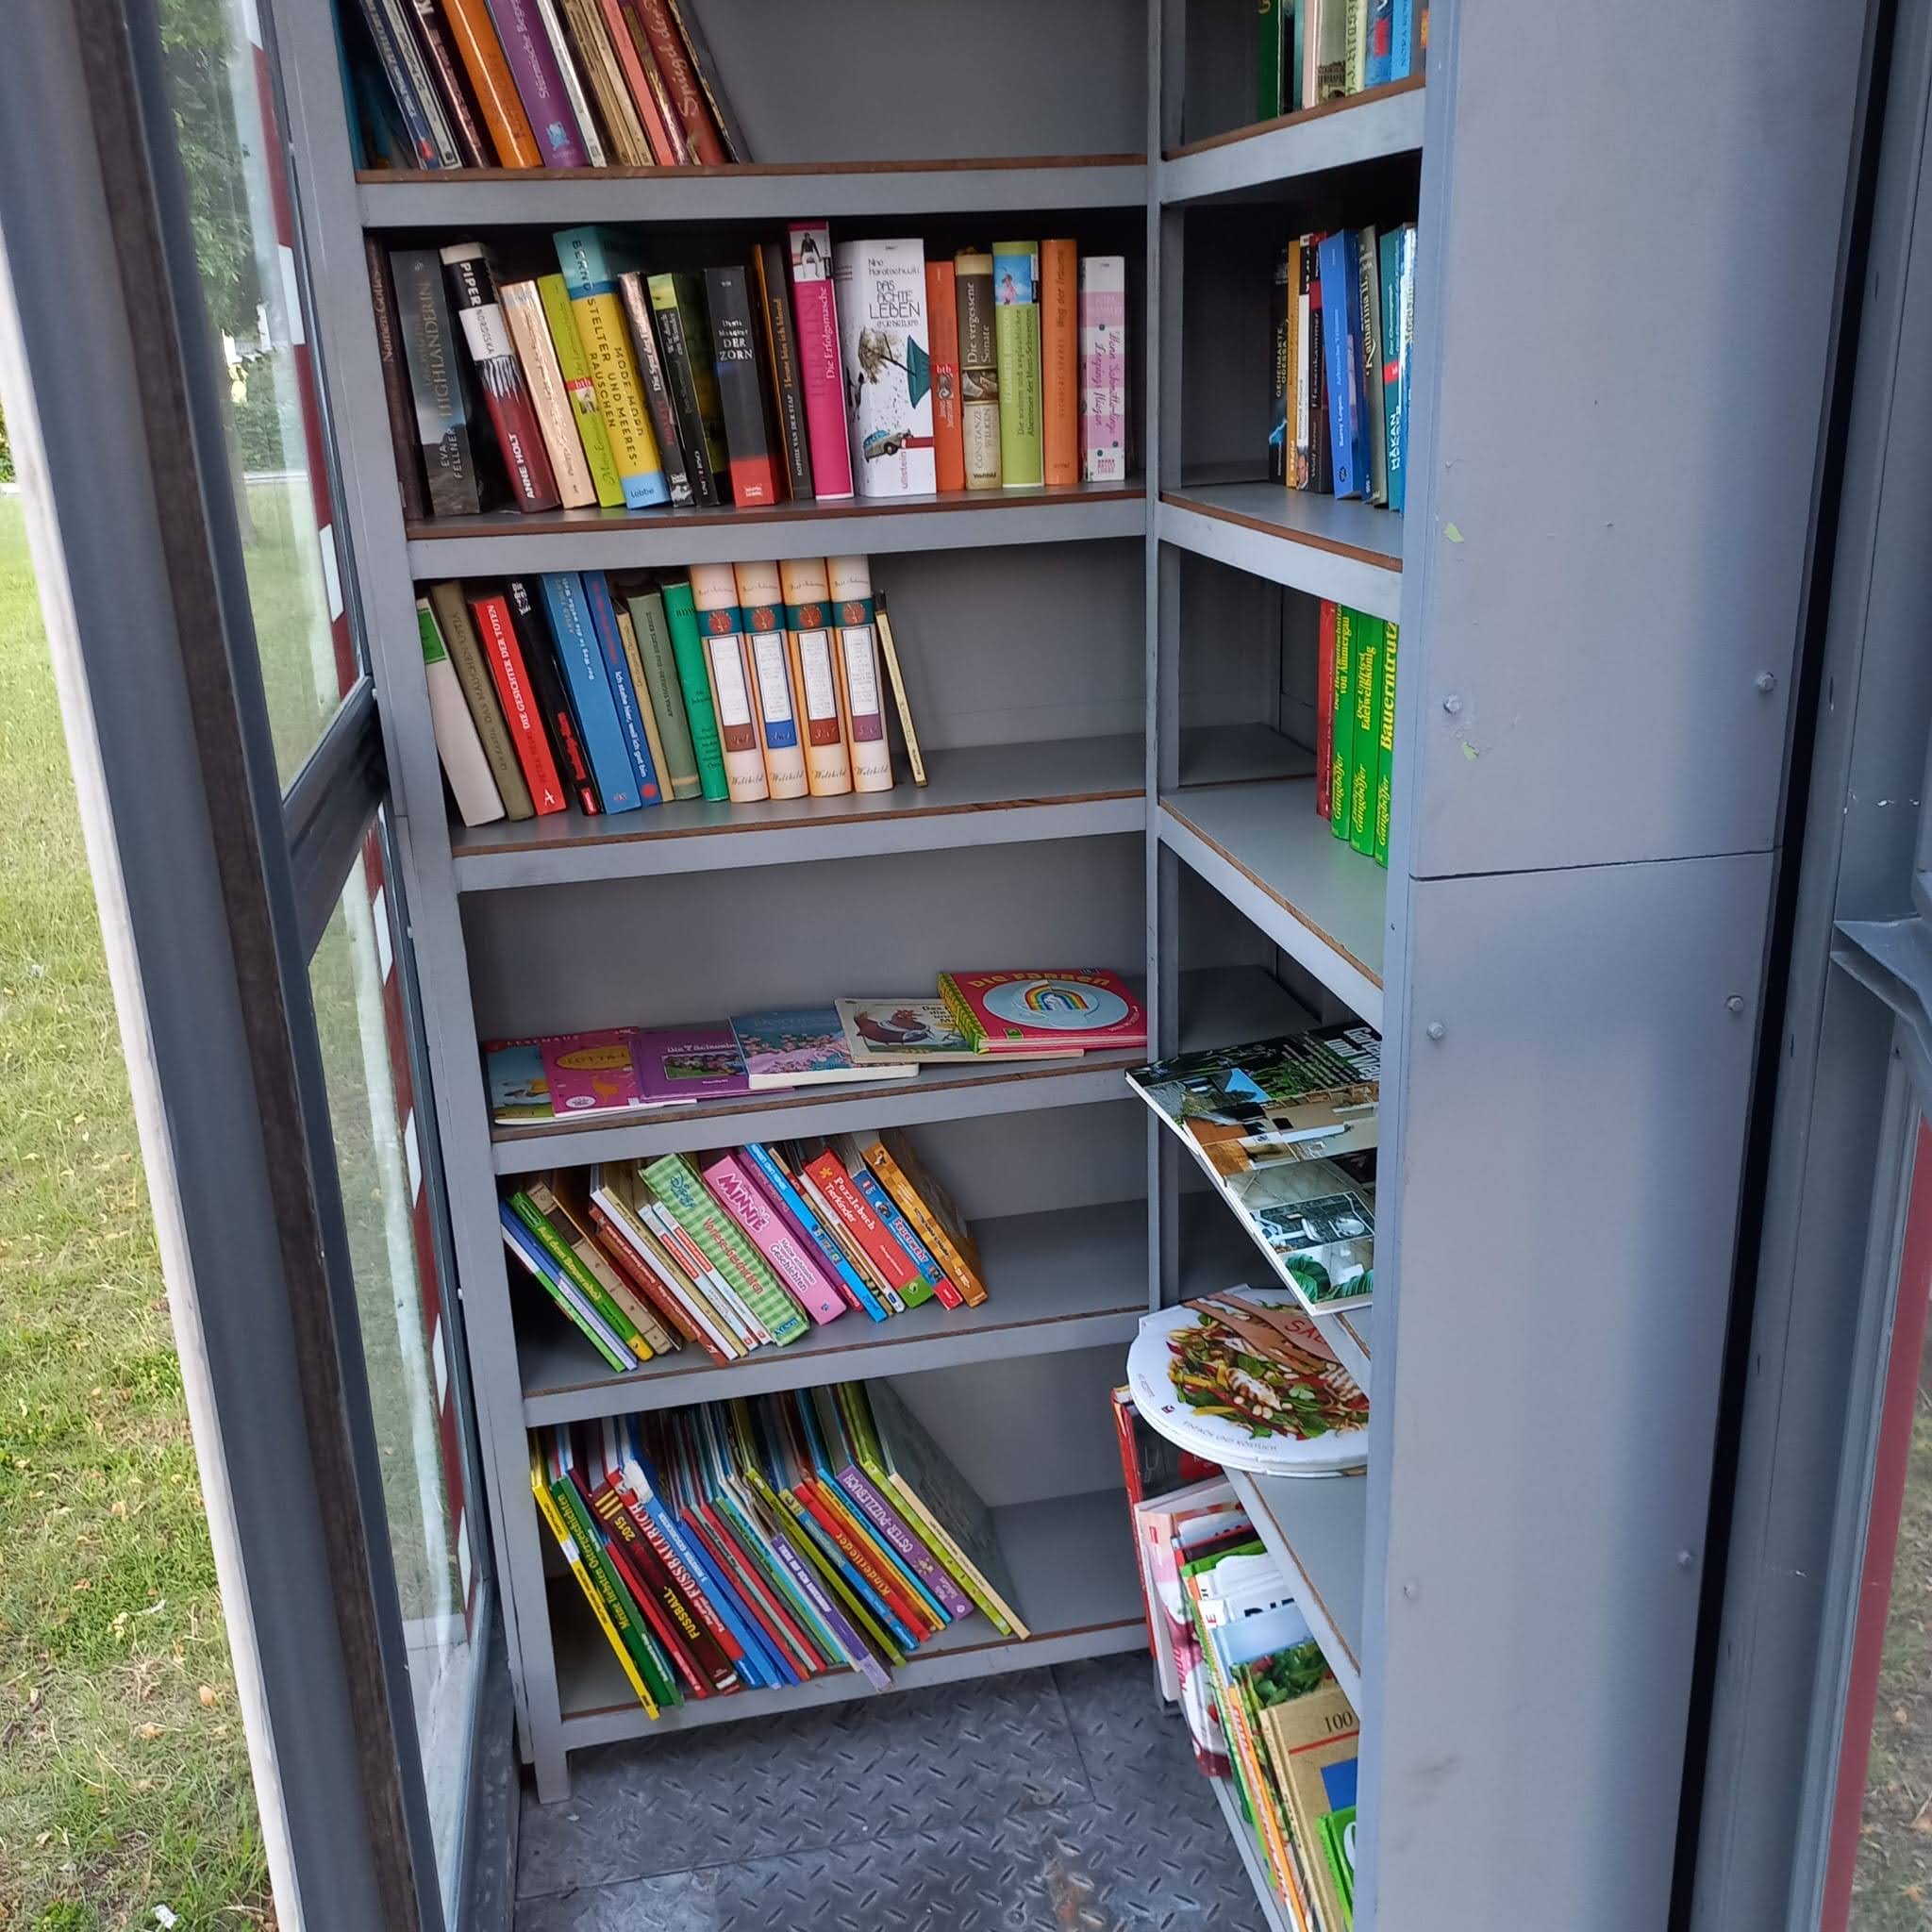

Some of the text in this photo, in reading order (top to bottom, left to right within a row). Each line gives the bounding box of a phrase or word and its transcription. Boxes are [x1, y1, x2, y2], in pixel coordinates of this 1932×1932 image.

[645, 6, 704, 120] Spiegel der
[460, 262, 481, 307] PIPER
[572, 239, 592, 292] BERND
[876, 280, 895, 291] DAS
[587, 297, 611, 363] STELTER
[818, 286, 836, 379] Die Erfolgsmasche
[870, 302, 921, 319] LEBEN
[967, 281, 979, 363] Die vergessene
[422, 281, 453, 419] HIGHLANDERIN
[643, 354, 659, 375] Spur
[719, 349, 754, 361] ZORN
[723, 339, 746, 348] DER
[981, 325, 991, 363] Sonate
[588, 350, 617, 429] RAUSCHEN
[649, 375, 662, 391] Die
[936, 364, 952, 375] btb
[606, 371, 641, 468] UND MEERES-
[1390, 413, 1401, 471] HÅKAN
[441, 445, 449, 468] EVA
[453, 427, 462, 479] FELLNER
[507, 430, 536, 499] ANNE HOLT
[900, 451, 909, 489] ullstein
[486, 603, 531, 729] DIE GESICHTER DER TOTEN
[1341, 617, 1352, 673] Ammergau
[613, 670, 624, 684] Ich
[1380, 622, 1398, 751] Bauerntrutz
[622, 704, 634, 723] hier,
[627, 721, 638, 739] weil
[631, 738, 641, 751] ich
[633, 750, 644, 764] gut
[638, 763, 648, 777] bin
[1335, 752, 1344, 820] Ganghofer
[1356, 764, 1367, 833] Ganghofer
[1379, 775, 1390, 846] Ganghofer
[665, 1171, 702, 1211] Disney
[714, 1171, 773, 1233] MINNIE
[823, 1181, 858, 1224] Tierkinder
[549, 1239, 567, 1258] dem
[891, 1215, 930, 1265] Feuerwehr
[768, 1242, 809, 1292] Geschichten
[553, 1491, 601, 1570] Ostergeschichten
[612, 1514, 636, 1542] 2015
[842, 1472, 914, 1555] OSTER-PUZZLEBUCH
[627, 1499, 701, 1600] FUSSBALLBUCH
[833, 1530, 891, 1597] Kinderlieder
[658, 1583, 700, 1640] FUSSBALL-
[1324, 1711, 1353, 1733] 100
